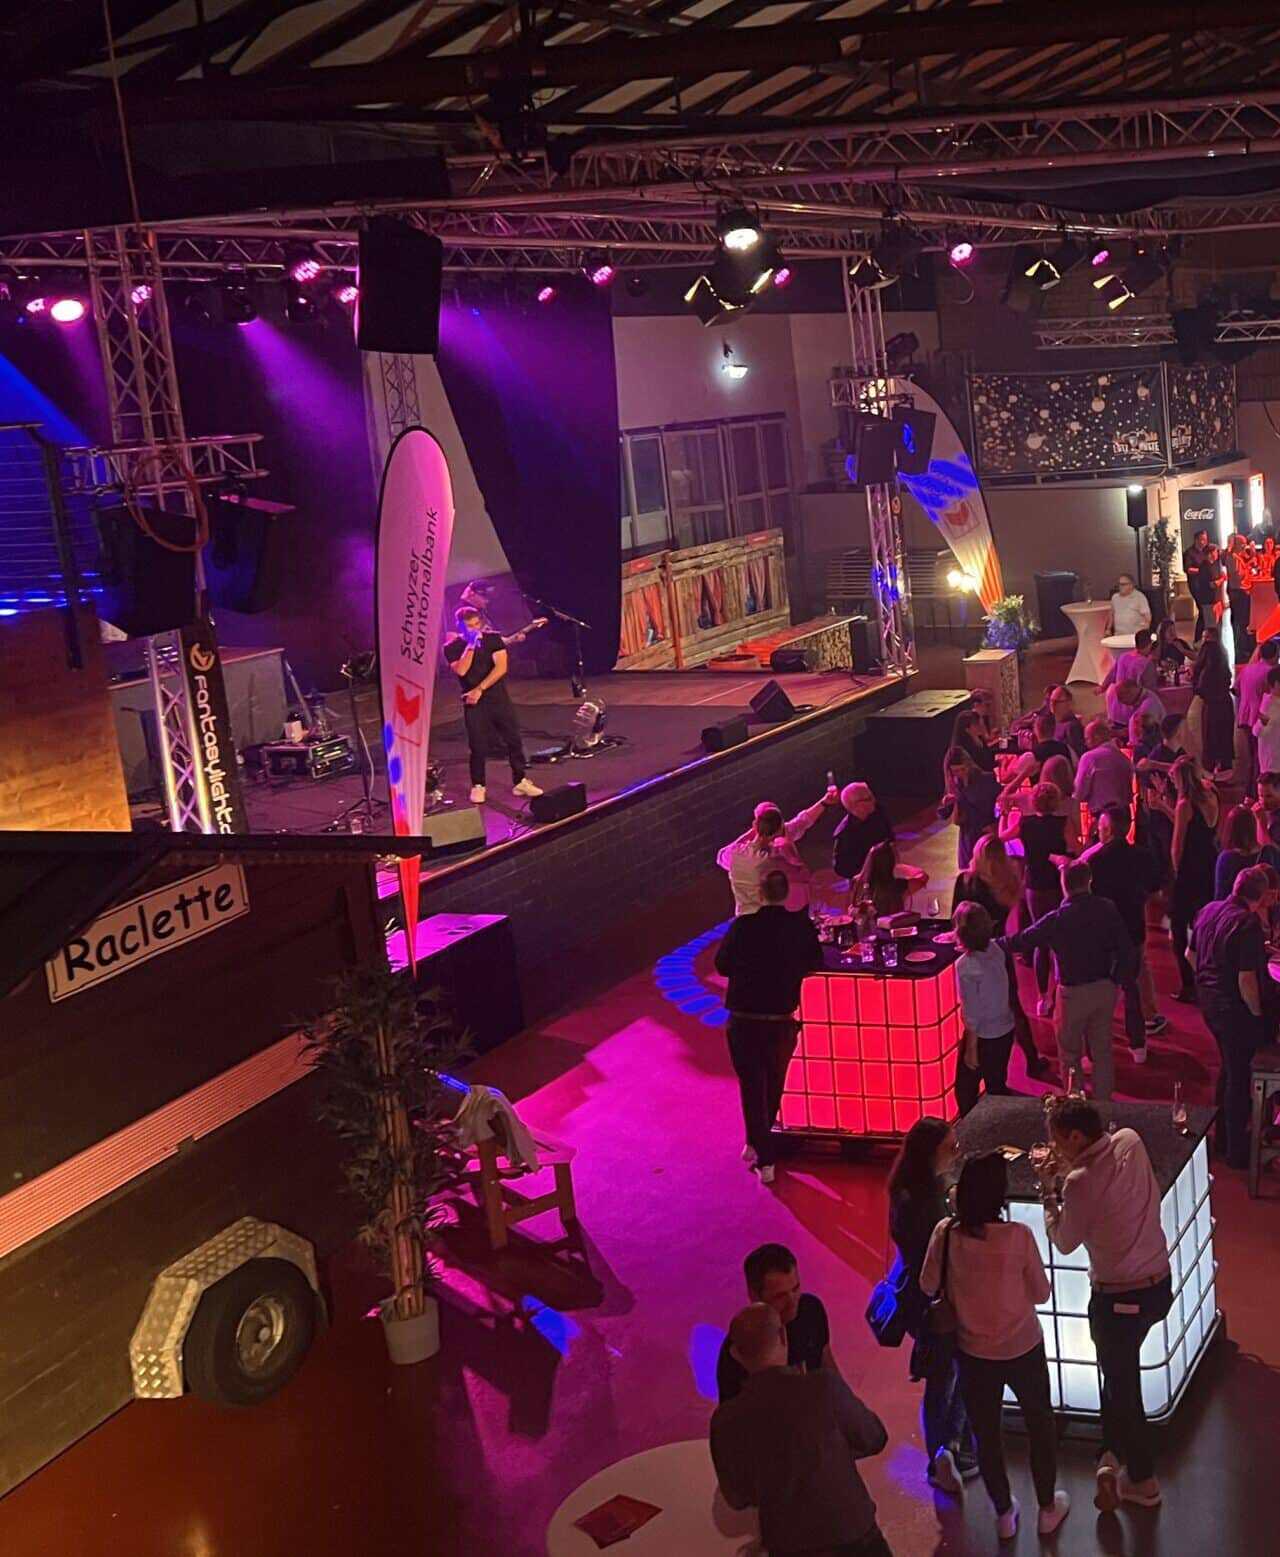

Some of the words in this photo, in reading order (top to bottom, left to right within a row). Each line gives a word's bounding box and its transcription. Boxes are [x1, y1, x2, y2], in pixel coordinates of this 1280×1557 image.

[401, 548, 420, 659] Schwyzer
[412, 507, 438, 665] Kantonalbank
[62, 883, 234, 981] Raclette
